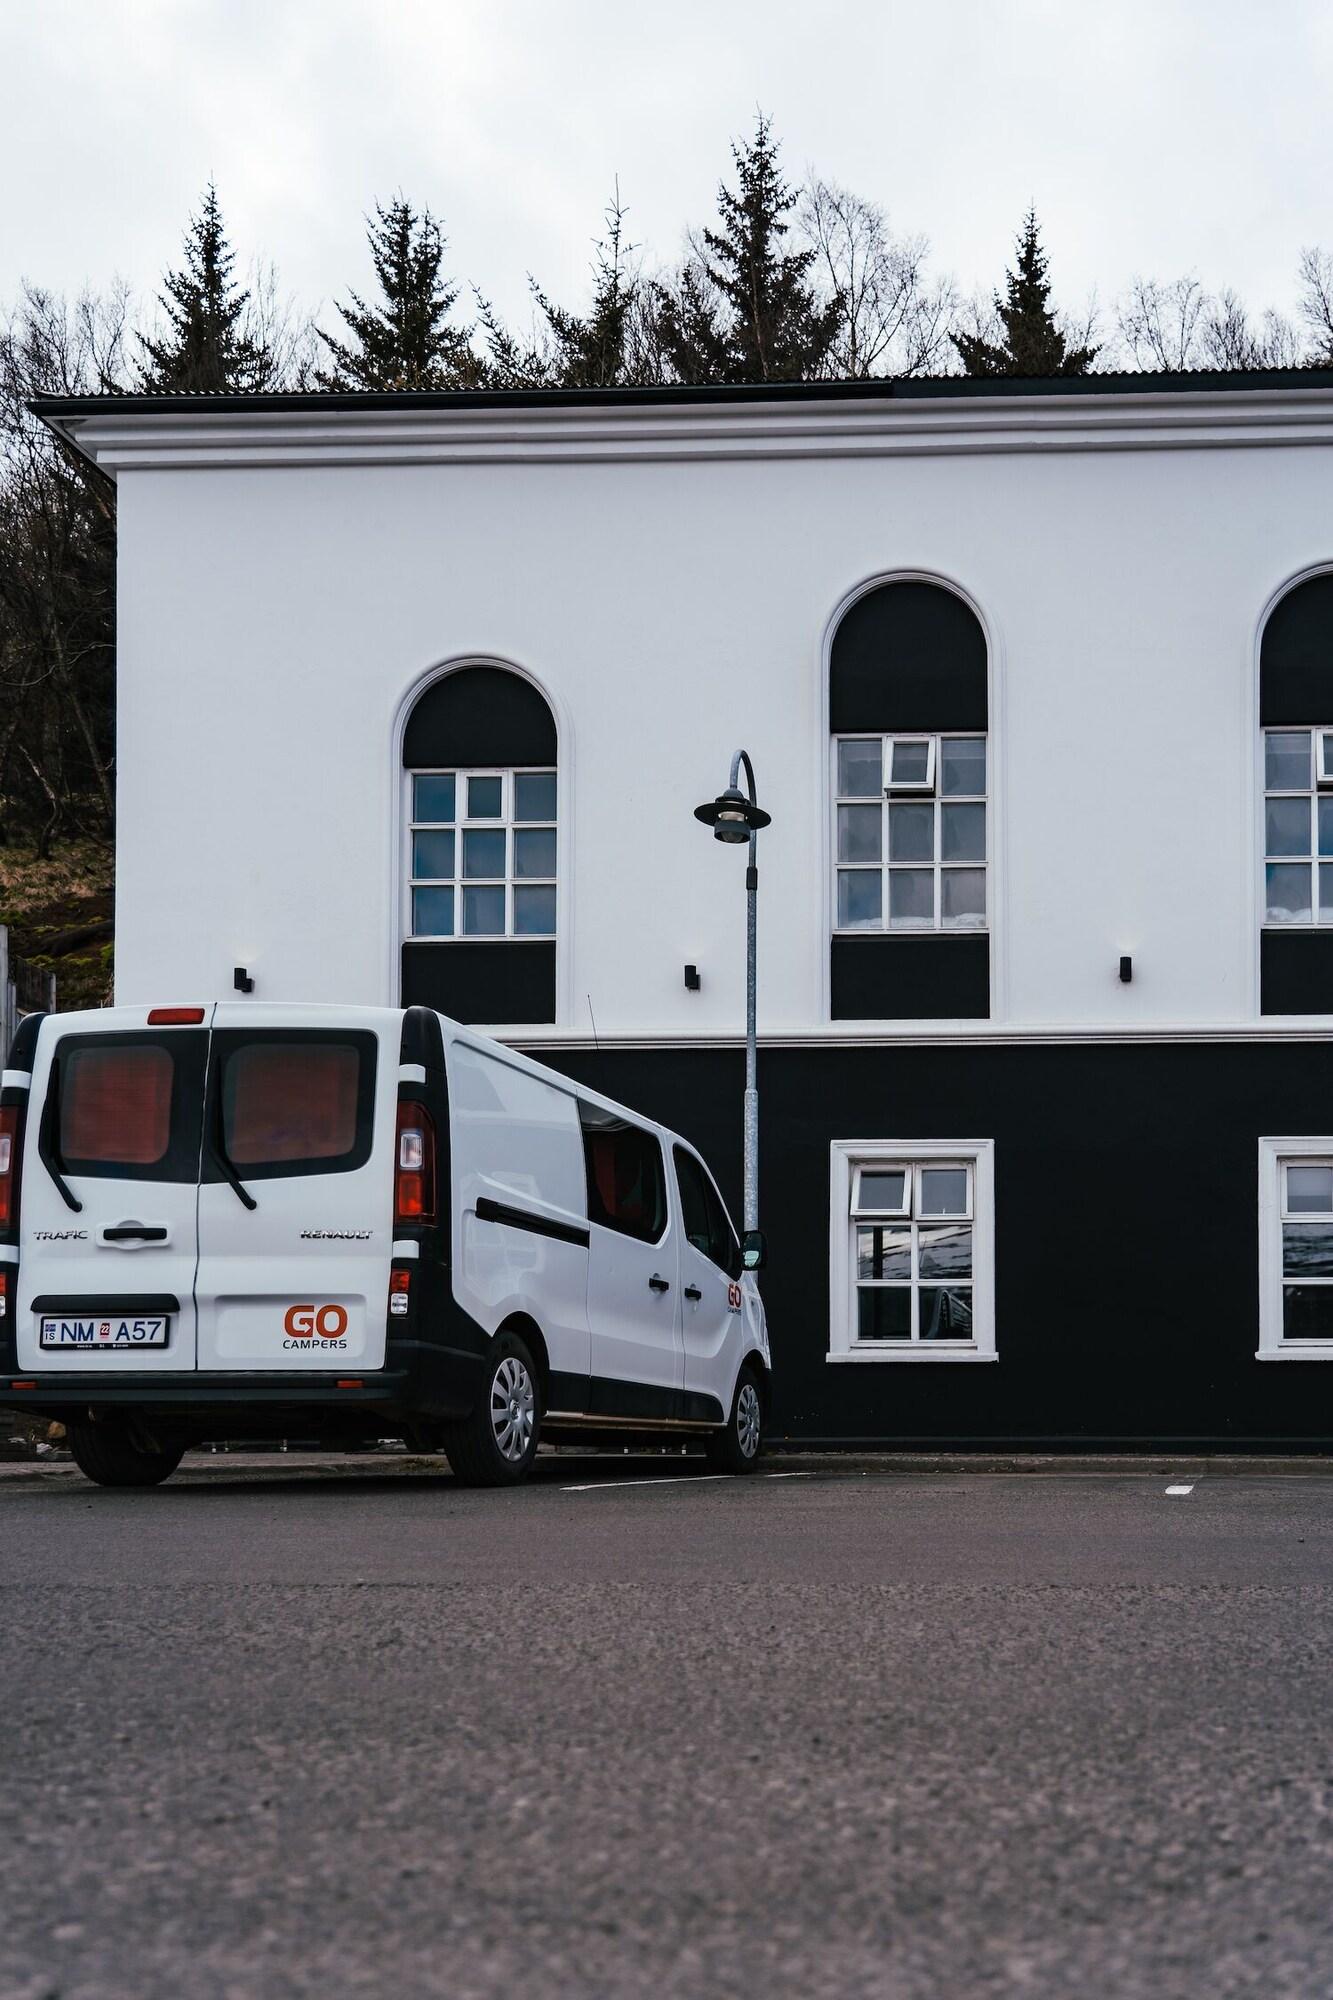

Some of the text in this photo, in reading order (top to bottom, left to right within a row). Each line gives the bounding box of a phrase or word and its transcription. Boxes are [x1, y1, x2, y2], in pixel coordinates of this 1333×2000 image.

[33, 1230, 88, 1240] TRAFIC
[301, 1230, 373, 1240] RENAULT
[728, 1283, 741, 1308] GO
[285, 1304, 348, 1338] GO
[60, 1322, 94, 1341] NM
[115, 1321, 161, 1341] A57
[282, 1340, 347, 1349] CAMPERS
